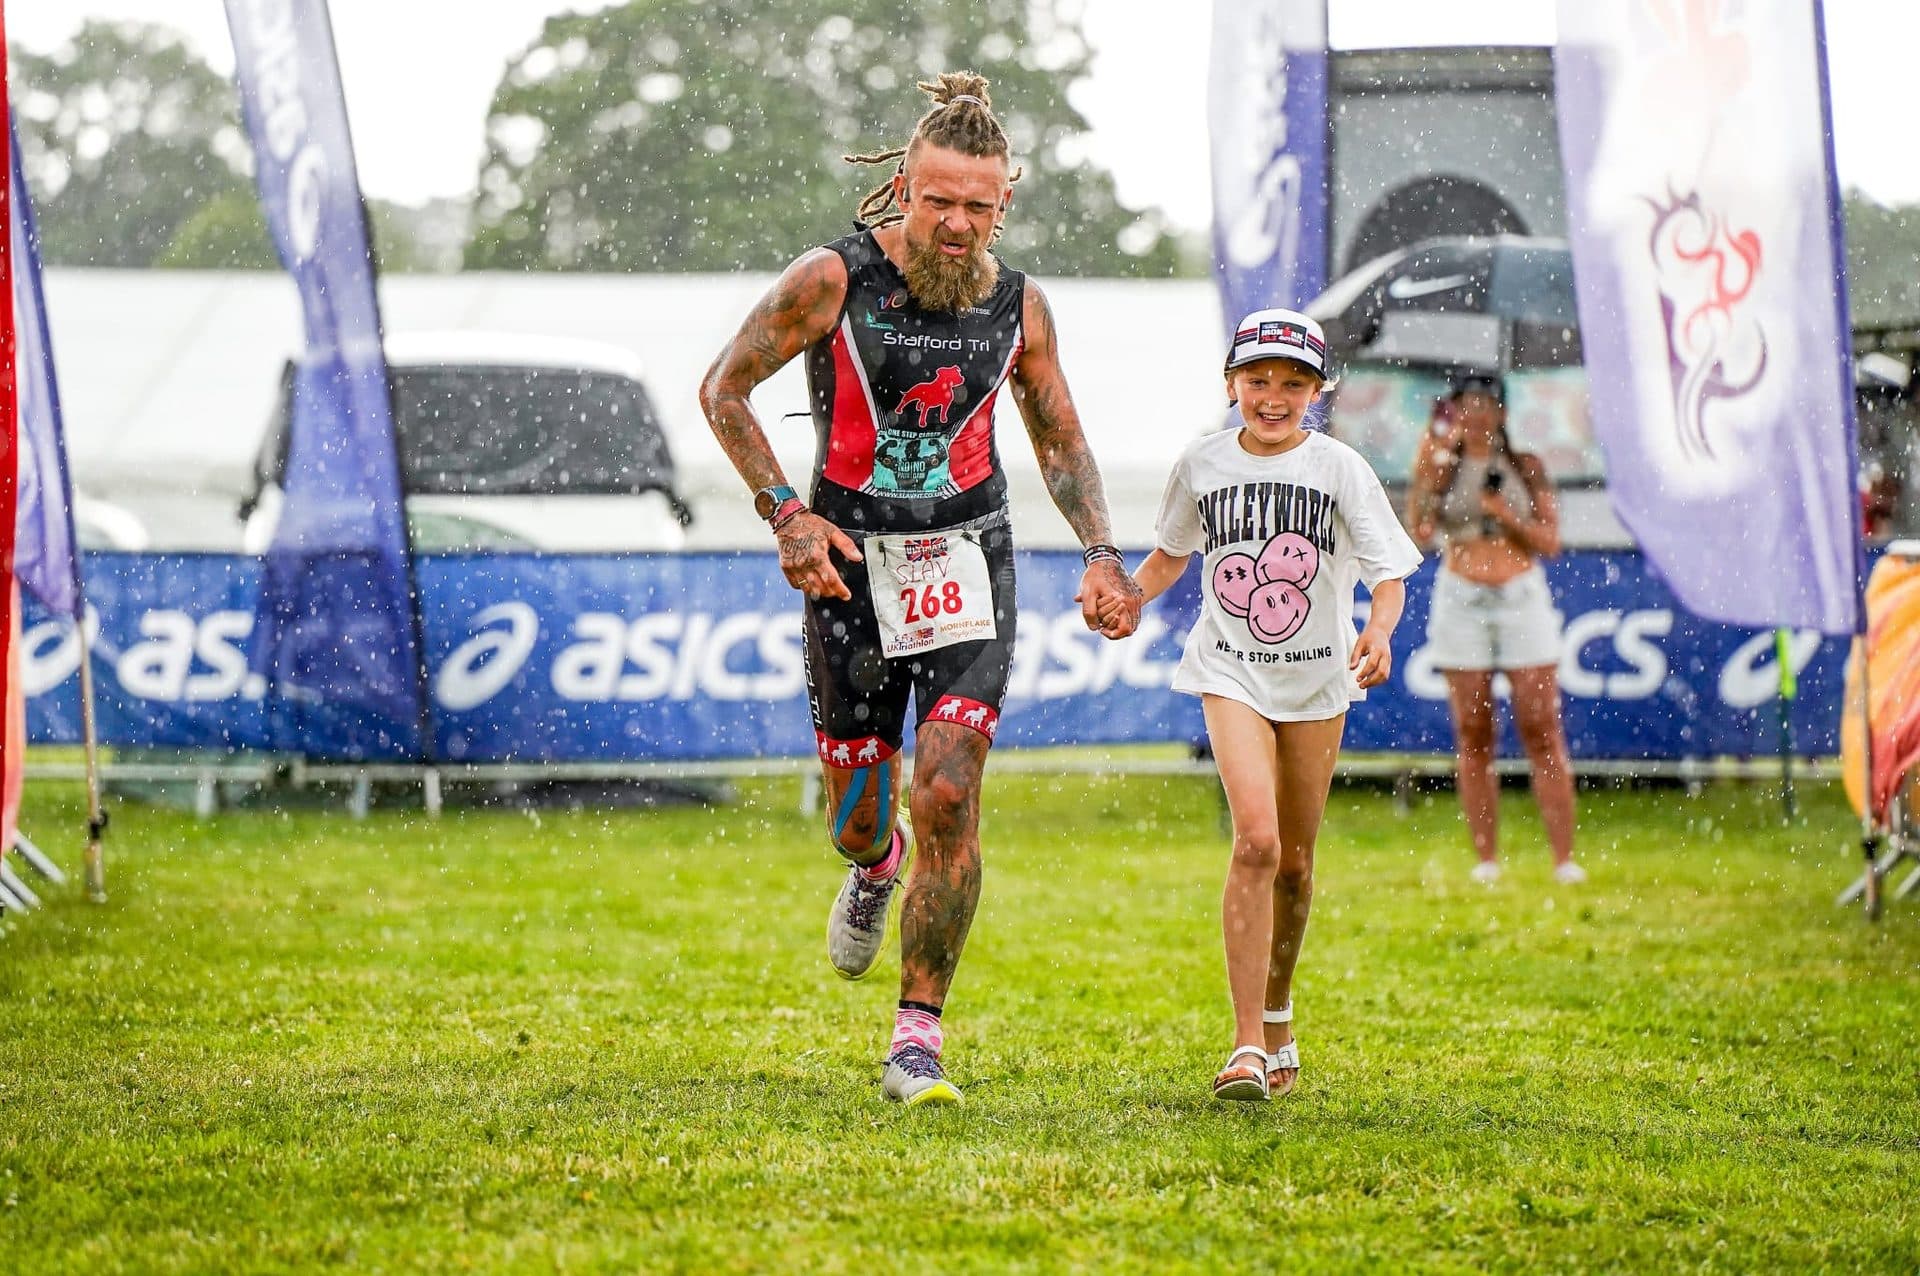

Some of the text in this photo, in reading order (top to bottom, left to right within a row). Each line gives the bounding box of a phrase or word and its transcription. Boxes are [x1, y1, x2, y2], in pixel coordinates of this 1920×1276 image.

[882, 332, 990, 352] Stafford Tri
[901, 430, 917, 438] STEP
[913, 461, 926, 472] NO
[896, 557, 952, 586] SLAV
[900, 581, 963, 625] 268
[939, 618, 992, 633] MORNFLAKE
[550, 612, 803, 700] asics
[1215, 640, 1333, 663] NER STOP SMILING
